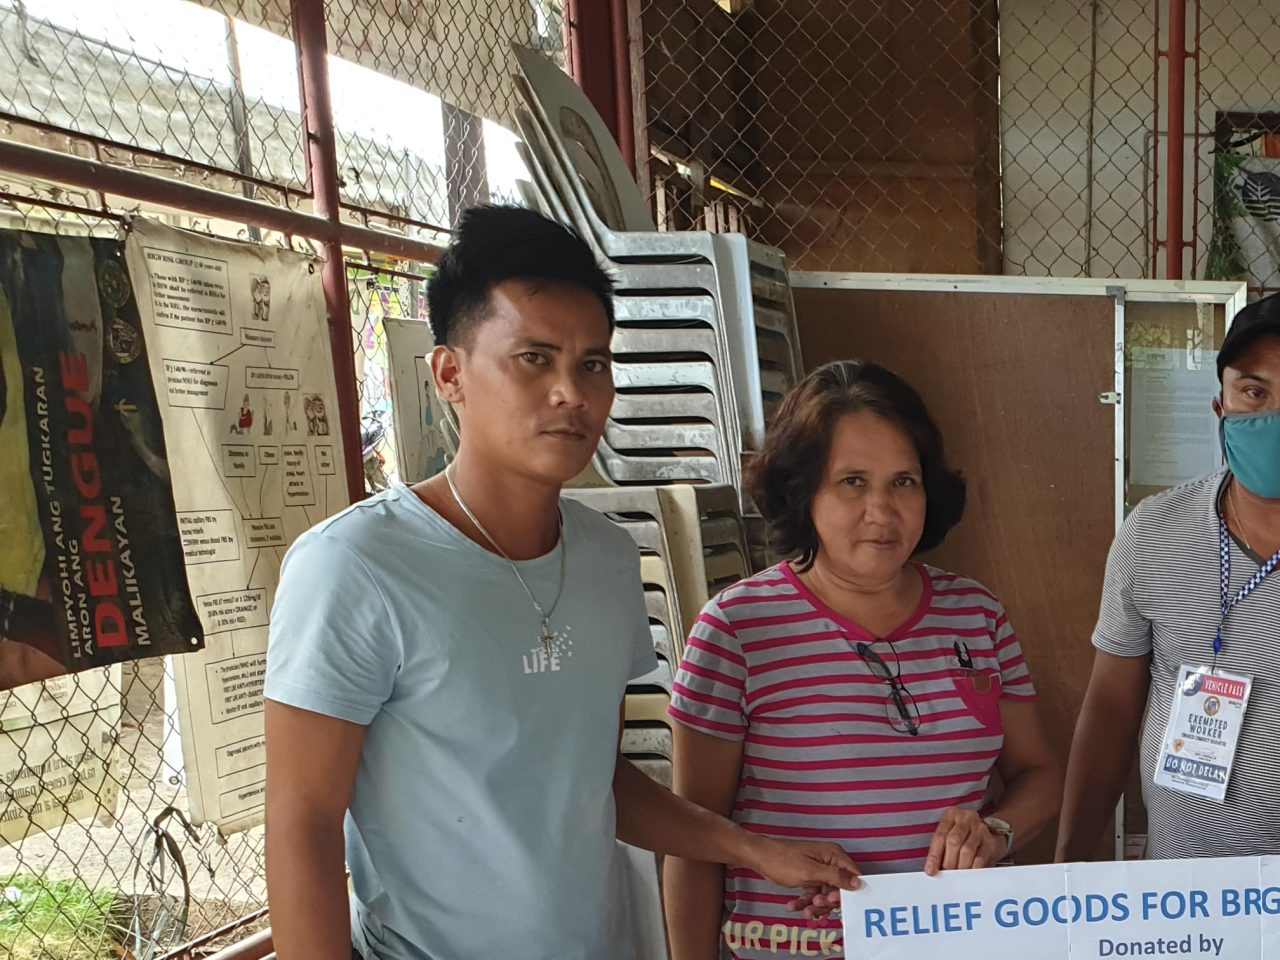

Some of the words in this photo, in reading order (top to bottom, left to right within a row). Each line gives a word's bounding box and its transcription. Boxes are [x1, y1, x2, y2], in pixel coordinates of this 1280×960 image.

[31, 366, 57, 495] TUGKARAN
[58, 350, 129, 648] DENGUE
[50, 500, 66, 549] ANG
[68, 539, 85, 588] ANG
[110, 496, 152, 646] MALIKAYAN
[57, 554, 82, 659] LIMPYOHI
[76, 593, 94, 656] ARON
[522, 650, 561, 674] LIFE
[1205, 679, 1228, 693] VEHICLE
[1188, 713, 1228, 731] EXEMPTED
[1189, 724, 1222, 740] WORKER
[1166, 757, 1178, 769] DO
[1179, 760, 1197, 775] NOT
[1198, 764, 1226, 782] DELAY
[864, 901, 982, 939] RELIEF
[995, 892, 1130, 930] GOODS
[1141, 888, 1210, 922] FOR
[769, 923, 842, 957] PICK
[1099, 934, 1193, 959] Donated
[1198, 933, 1225, 957] by
